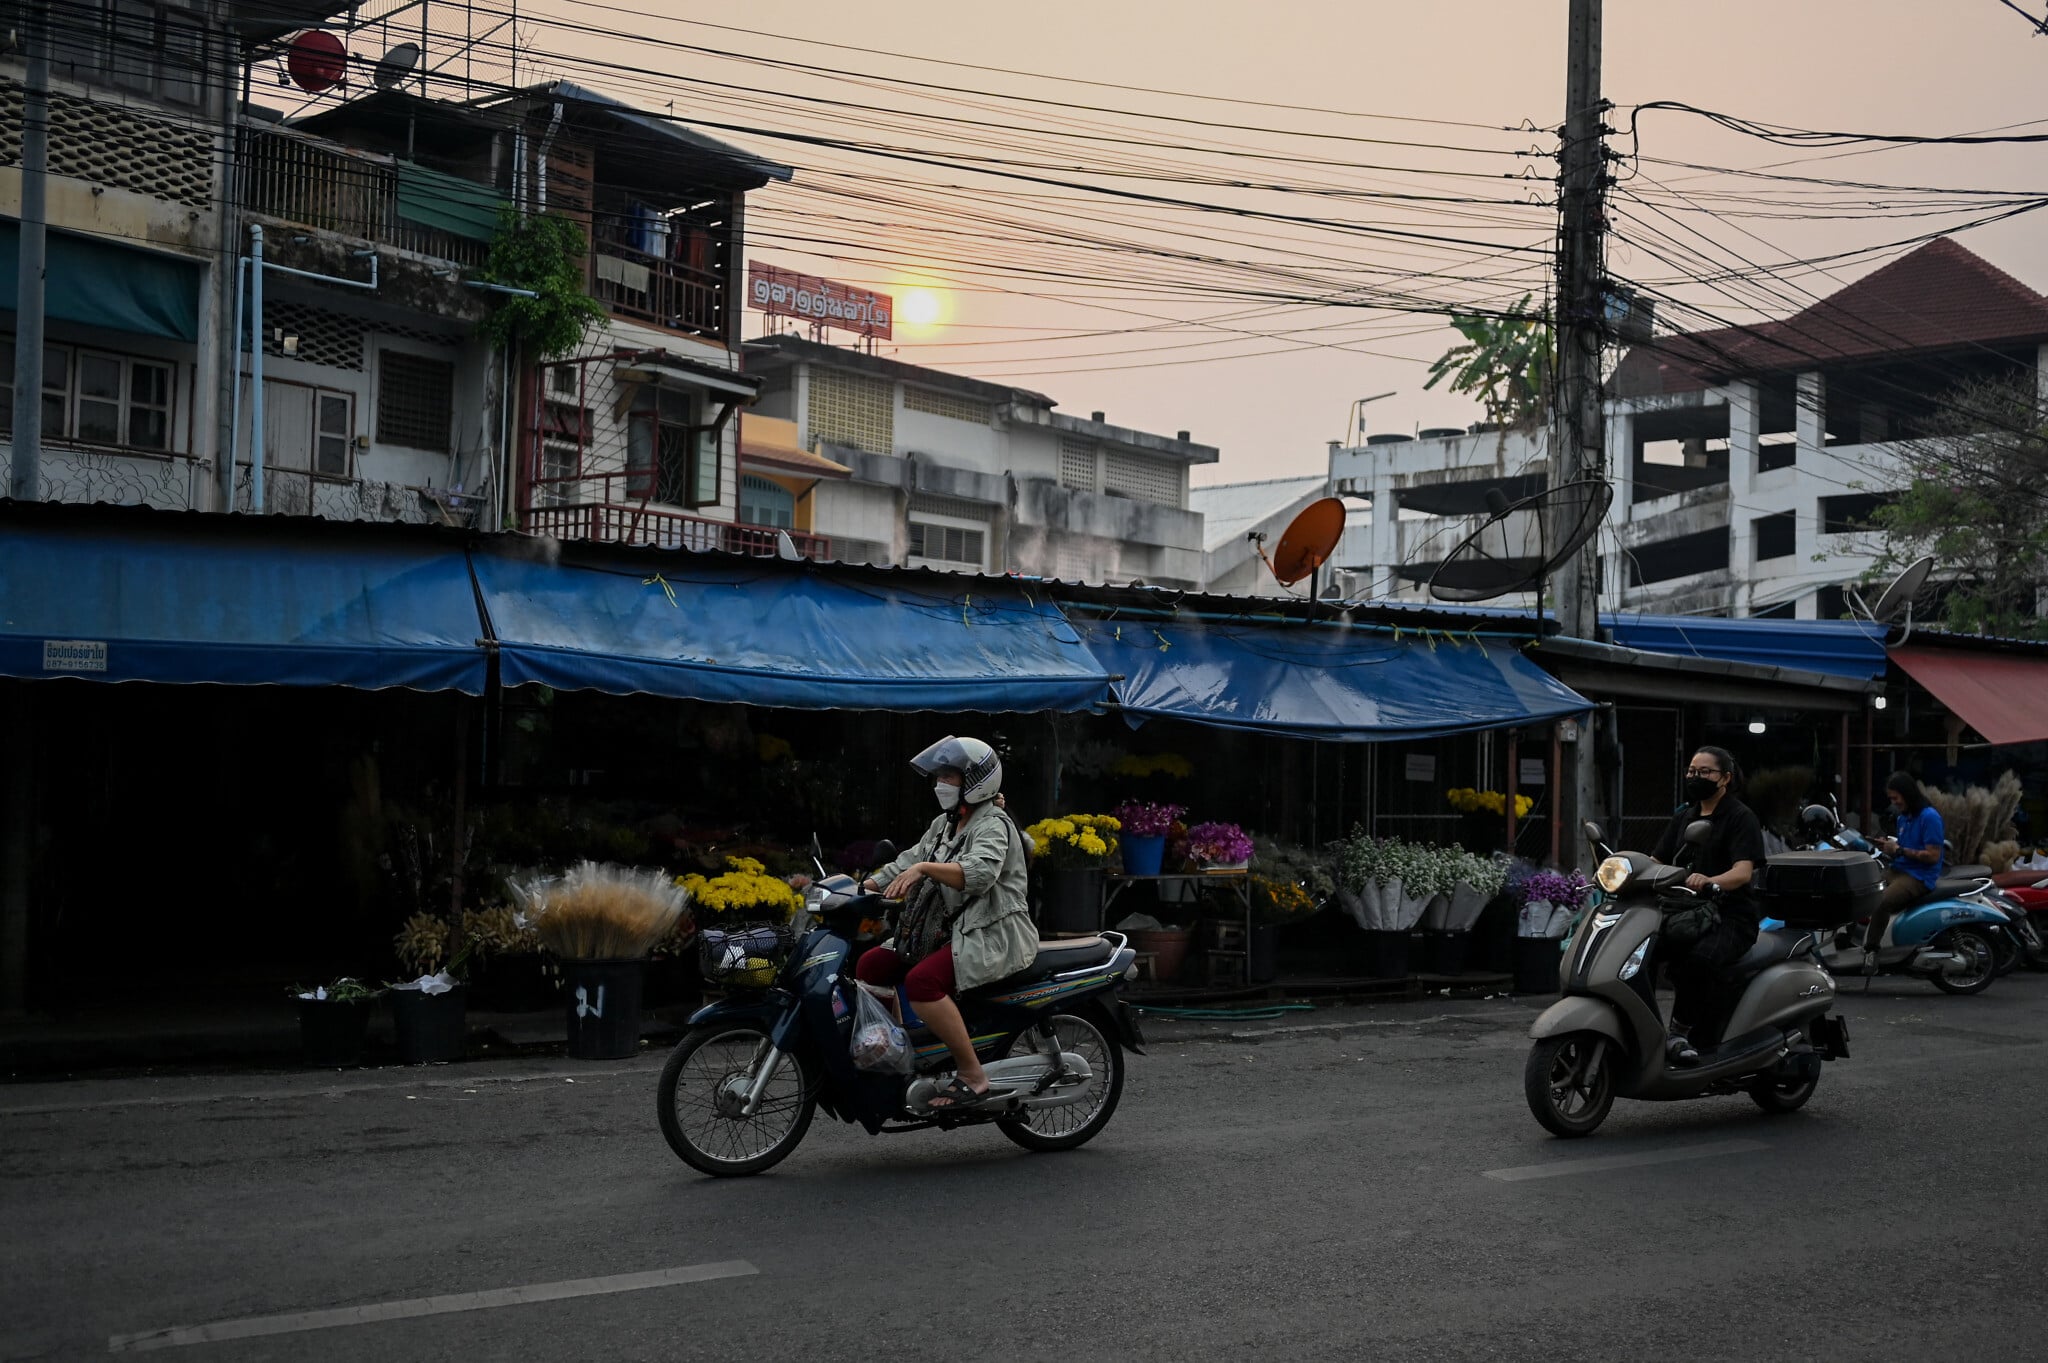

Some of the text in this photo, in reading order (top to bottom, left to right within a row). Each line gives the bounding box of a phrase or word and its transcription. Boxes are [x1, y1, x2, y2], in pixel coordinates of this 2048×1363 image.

[754, 278, 889, 328] ตลาดต้นลำไย
